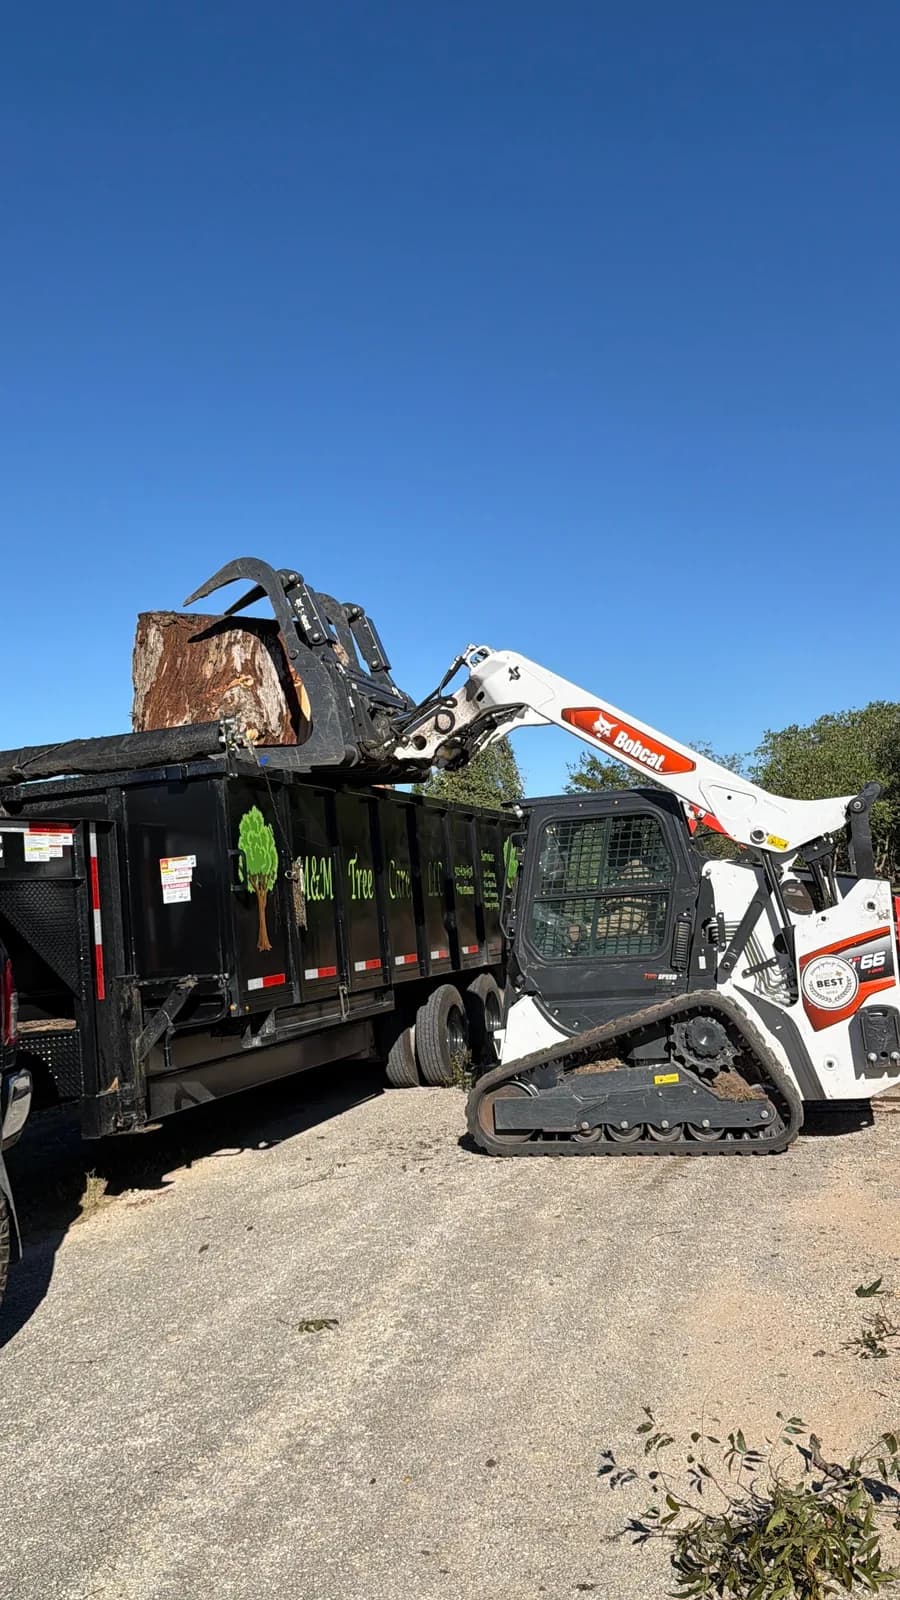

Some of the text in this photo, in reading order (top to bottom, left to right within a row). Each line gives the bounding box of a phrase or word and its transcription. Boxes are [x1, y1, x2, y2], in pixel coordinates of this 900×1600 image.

[613, 730, 665, 771] Bobcat
[348, 852, 374, 900] Tree
[816, 977, 844, 988] BEST
